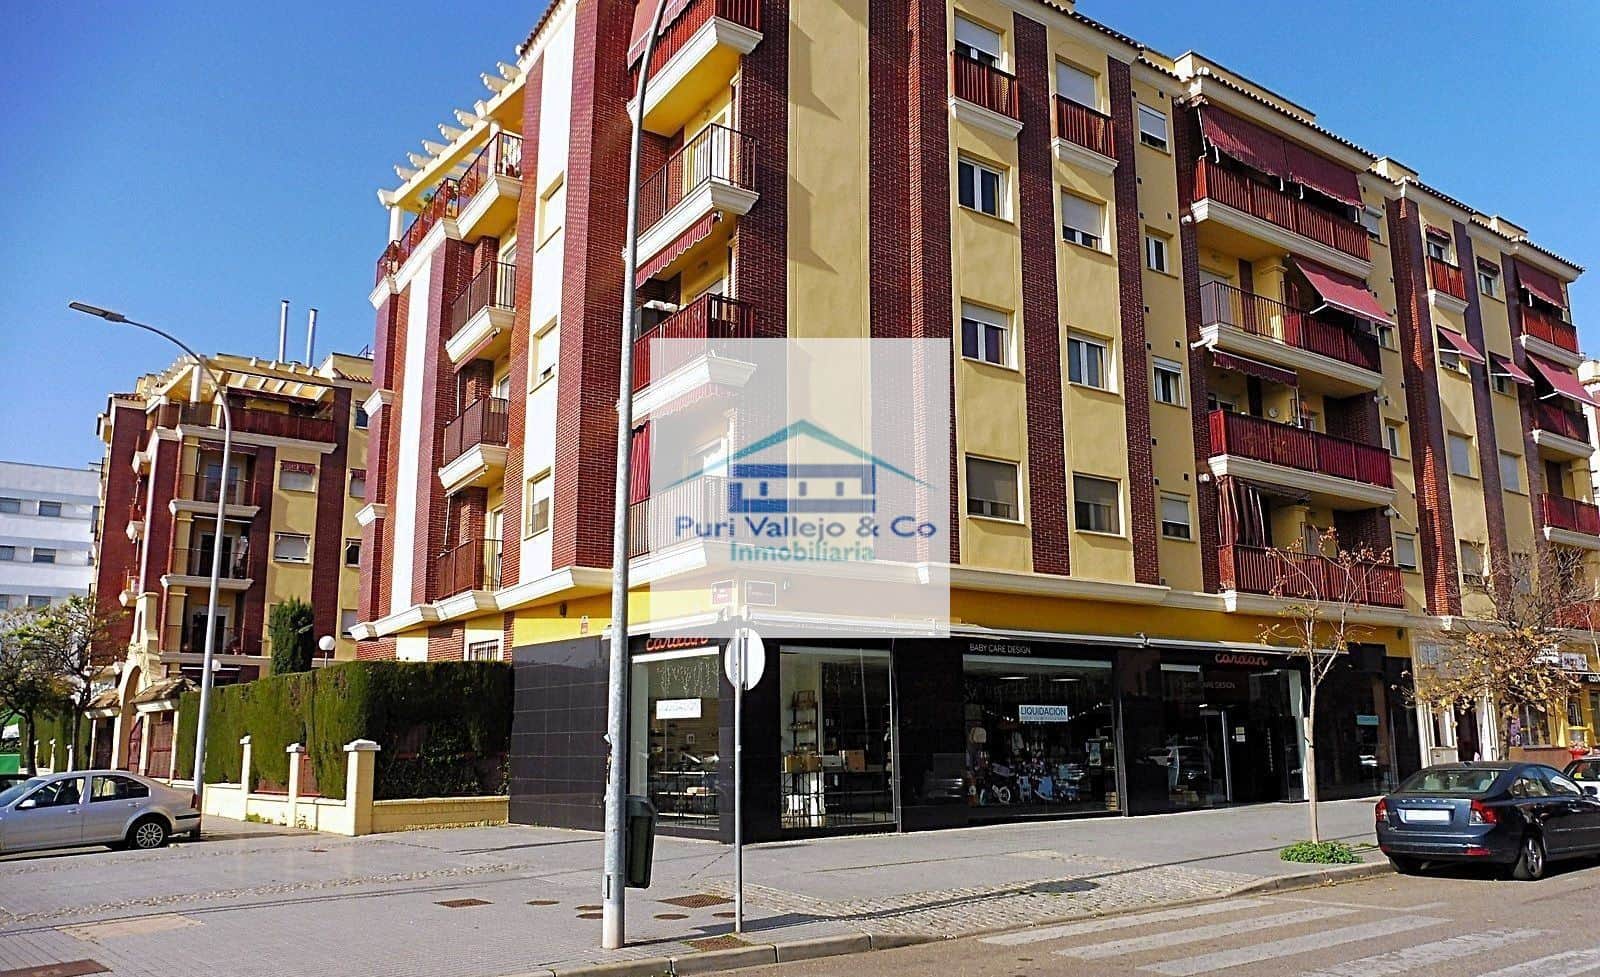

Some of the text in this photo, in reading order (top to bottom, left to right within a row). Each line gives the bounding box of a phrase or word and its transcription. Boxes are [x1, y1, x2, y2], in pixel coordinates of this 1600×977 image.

[969, 643, 1031, 654] BABY CARE DESIGN
